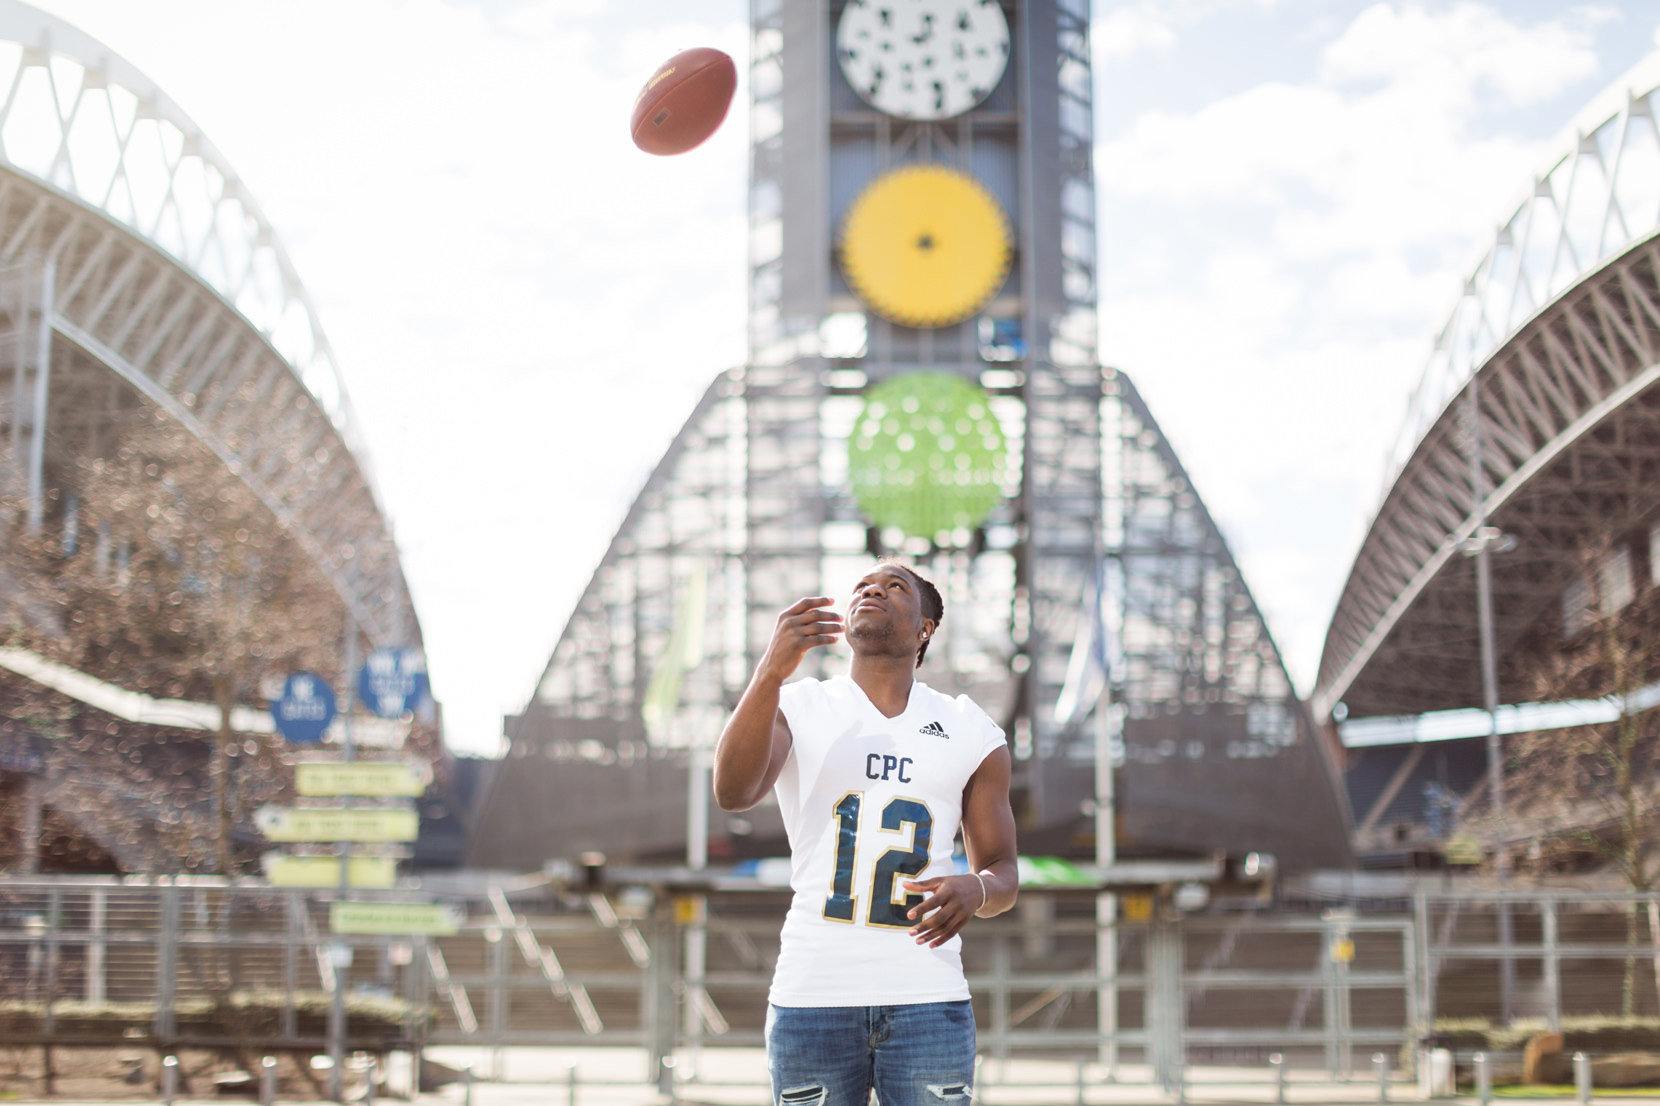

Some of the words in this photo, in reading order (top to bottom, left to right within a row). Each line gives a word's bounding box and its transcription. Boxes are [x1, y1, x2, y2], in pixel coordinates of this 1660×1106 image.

[919, 728, 950, 740] adidas
[866, 753, 913, 784] CPC
[822, 790, 935, 930] 12
